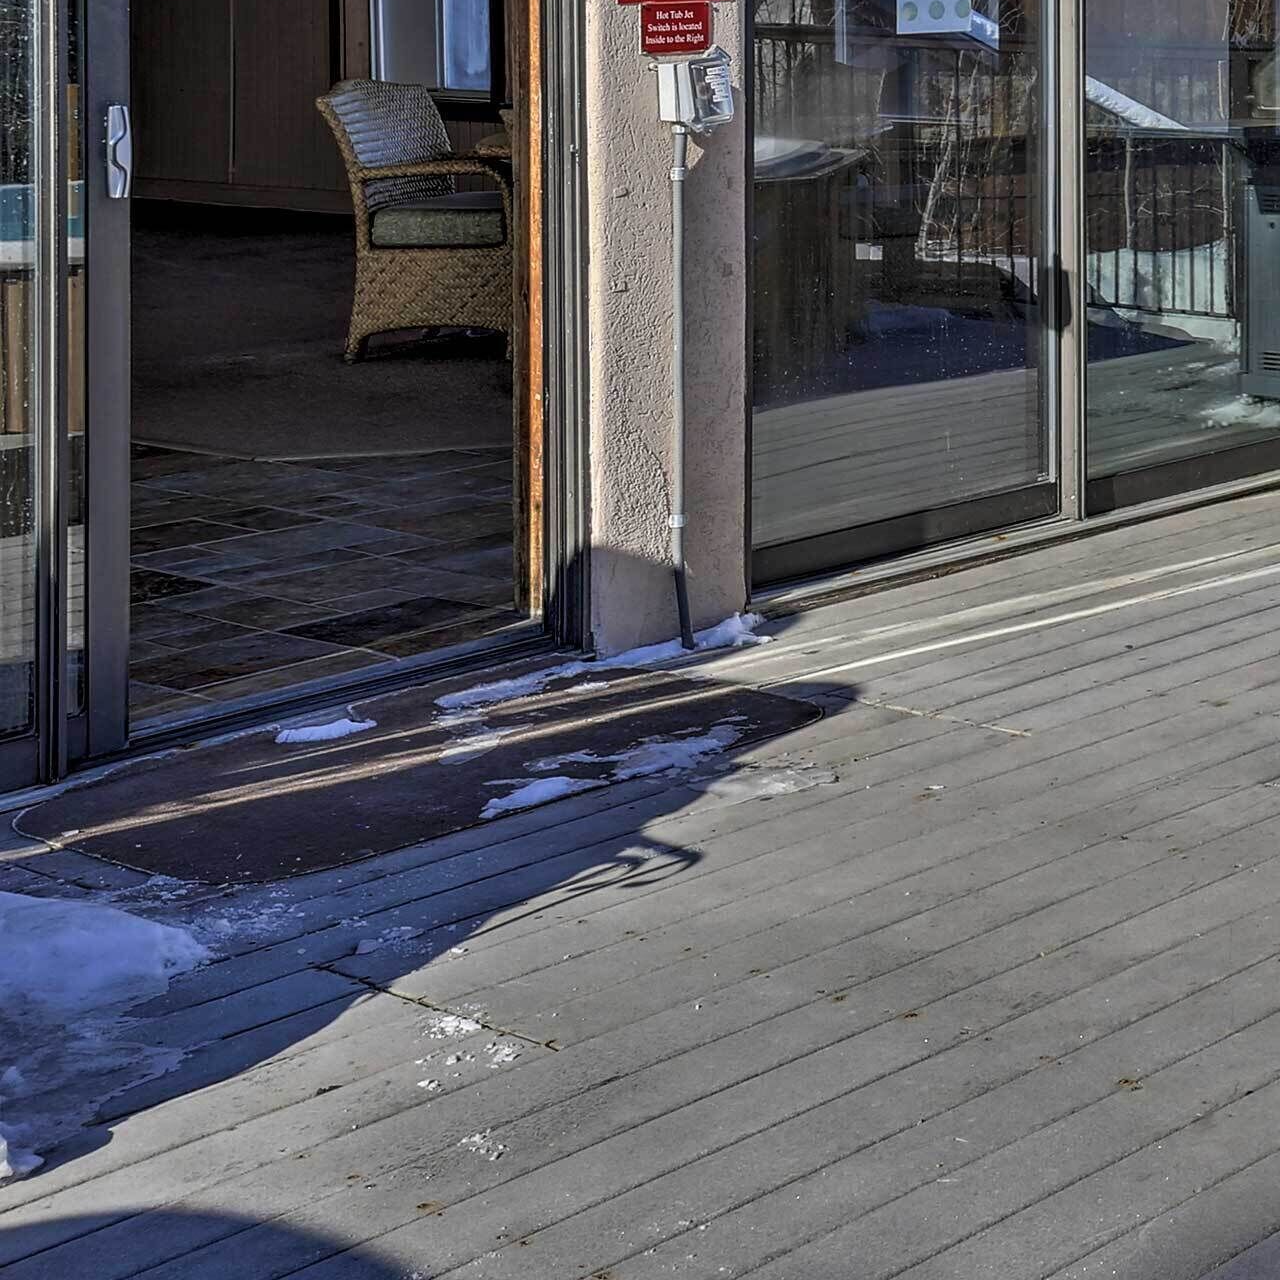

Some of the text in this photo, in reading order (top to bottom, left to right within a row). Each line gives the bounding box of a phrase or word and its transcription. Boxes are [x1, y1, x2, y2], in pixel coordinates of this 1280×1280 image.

[656, 10, 694, 20] Hot Tub Jet
[647, 23, 670, 32] Switch
[679, 22, 702, 30] located
[645, 35, 666, 44] Inside
[674, 34, 685, 42] the
[686, 33, 704, 44] Right
